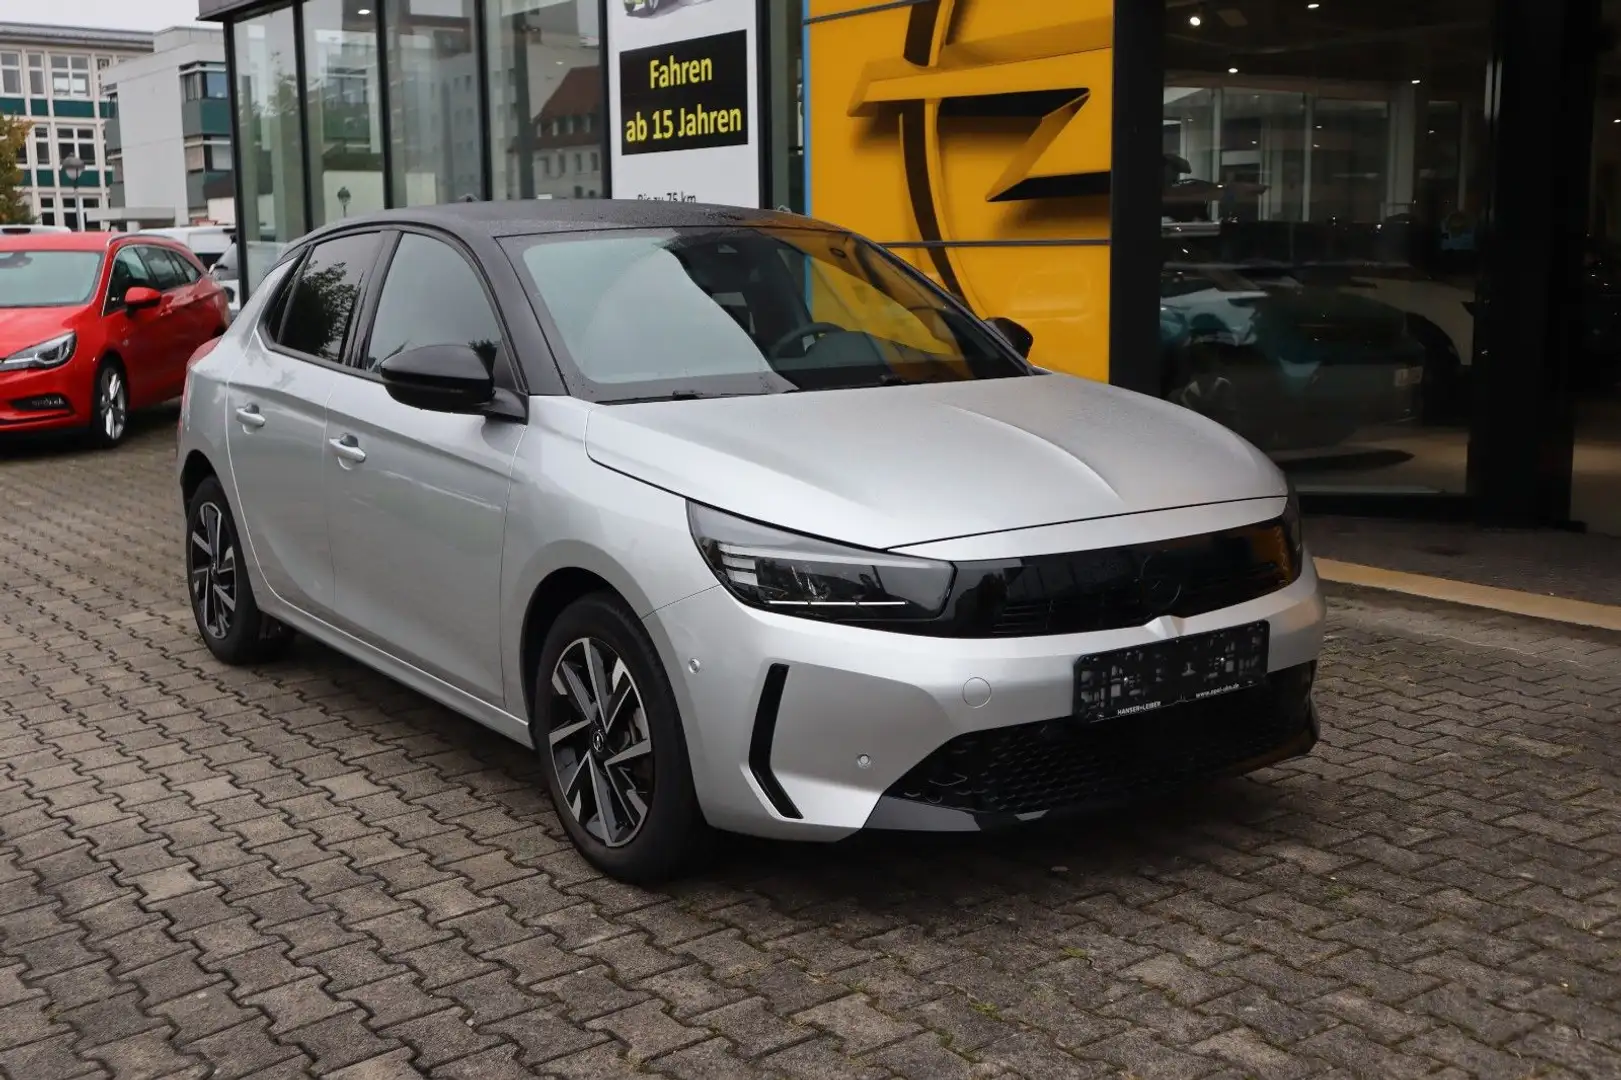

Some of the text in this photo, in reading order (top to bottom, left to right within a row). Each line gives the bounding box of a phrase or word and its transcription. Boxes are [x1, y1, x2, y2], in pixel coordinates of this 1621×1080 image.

[650, 55, 712, 89] Fahren
[626, 104, 742, 143] ab 15 Jahren
[666, 192, 678, 202] 75
[681, 191, 697, 203] km
